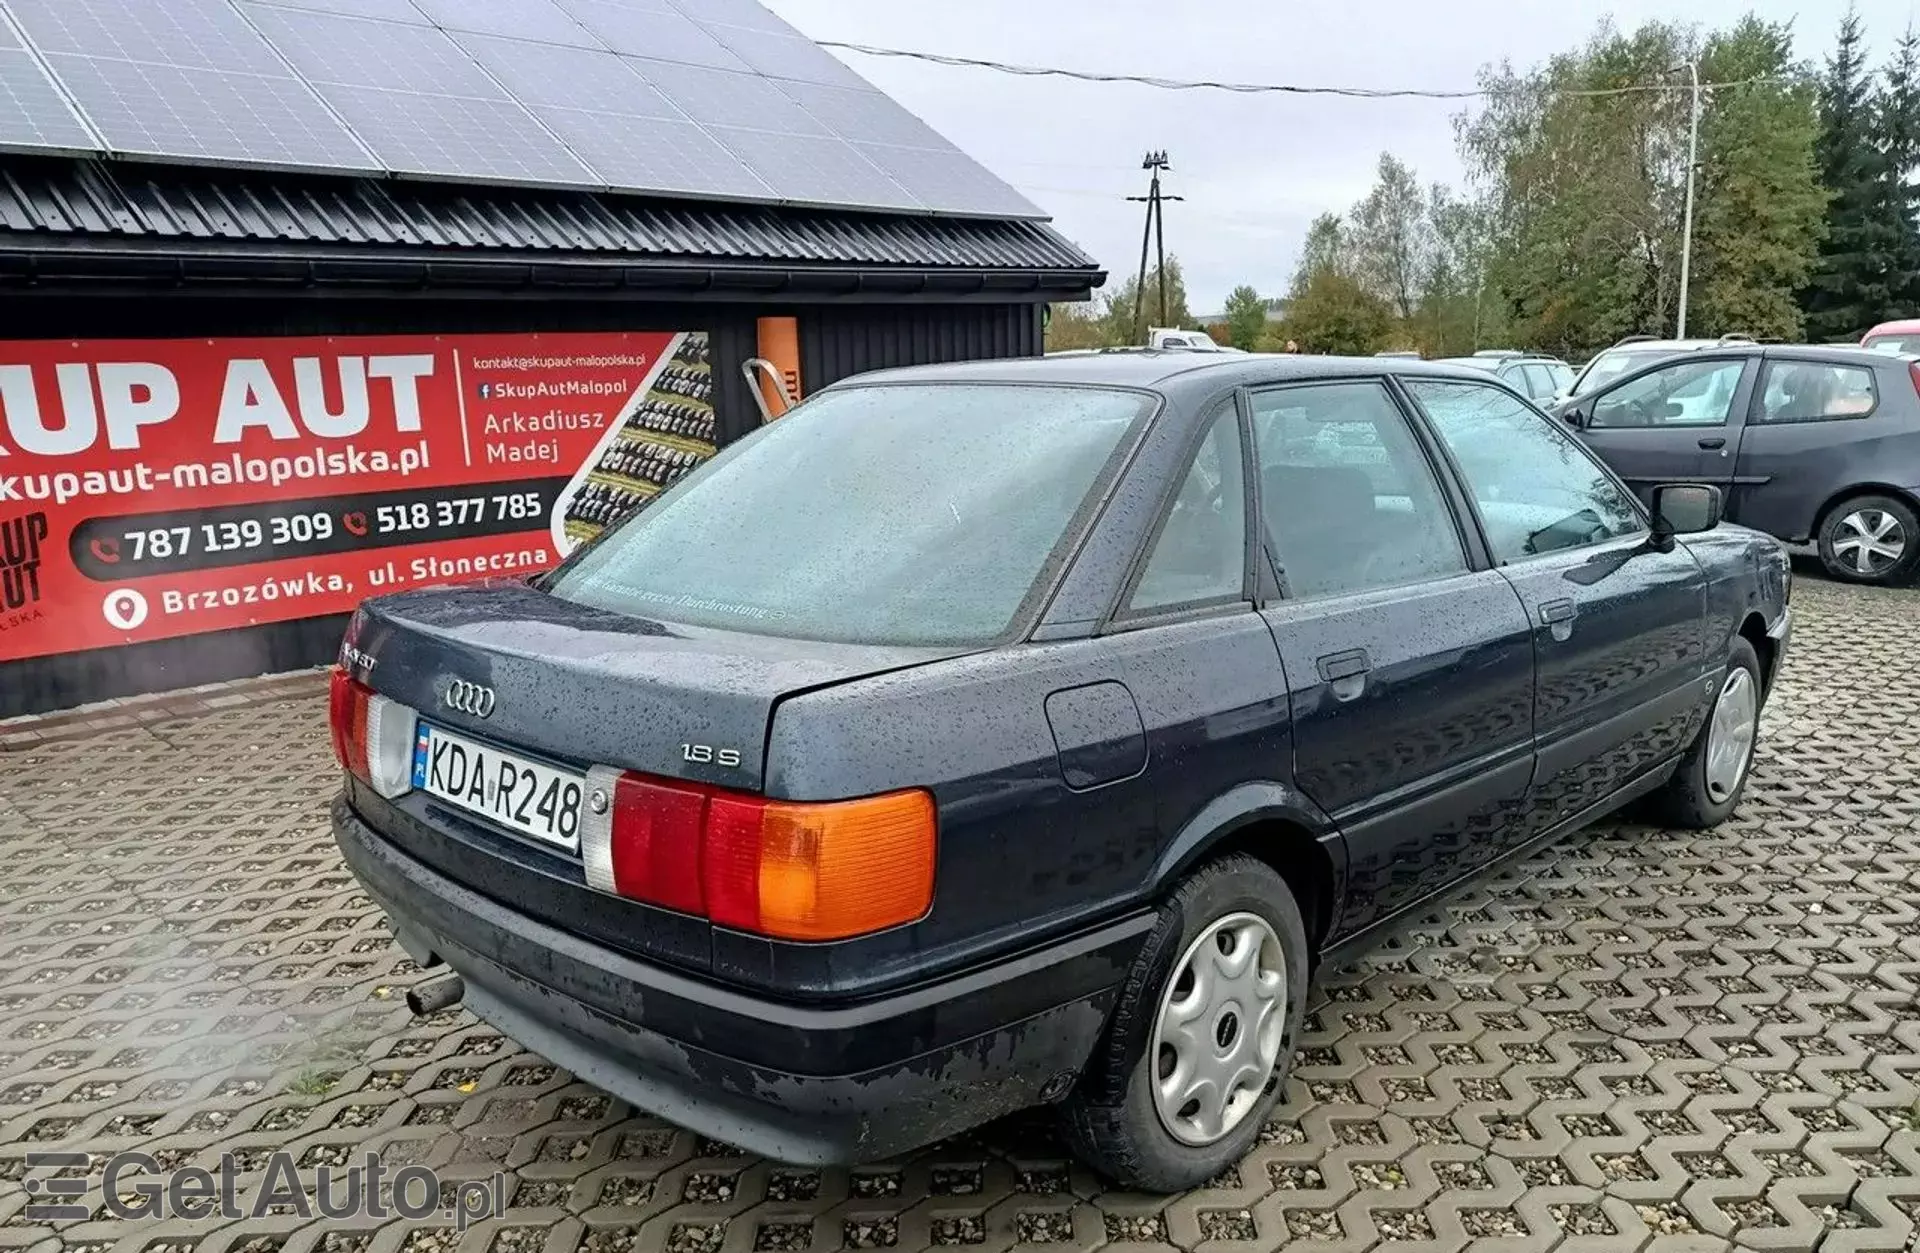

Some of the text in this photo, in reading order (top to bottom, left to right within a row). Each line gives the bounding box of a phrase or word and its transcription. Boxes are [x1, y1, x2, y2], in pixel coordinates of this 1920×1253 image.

[473, 353, 646, 371] kontakt@skupaut-malopolska.pl
[0, 354, 435, 456] UP AUT
[495, 379, 627, 399] SkupAutMalopol
[484, 409, 604, 435] Arkadiusz
[486, 437, 559, 464] Madej
[376, 492, 542, 534] 518 377 785
[0, 511, 48, 568] UP
[124, 512, 333, 561] 787 139 309
[0, 559, 41, 613] UT
[162, 548, 548, 615] Brzozówka, ul. Słoneczna
[717, 748, 741, 768] S
[430, 737, 582, 839] KDA R248
